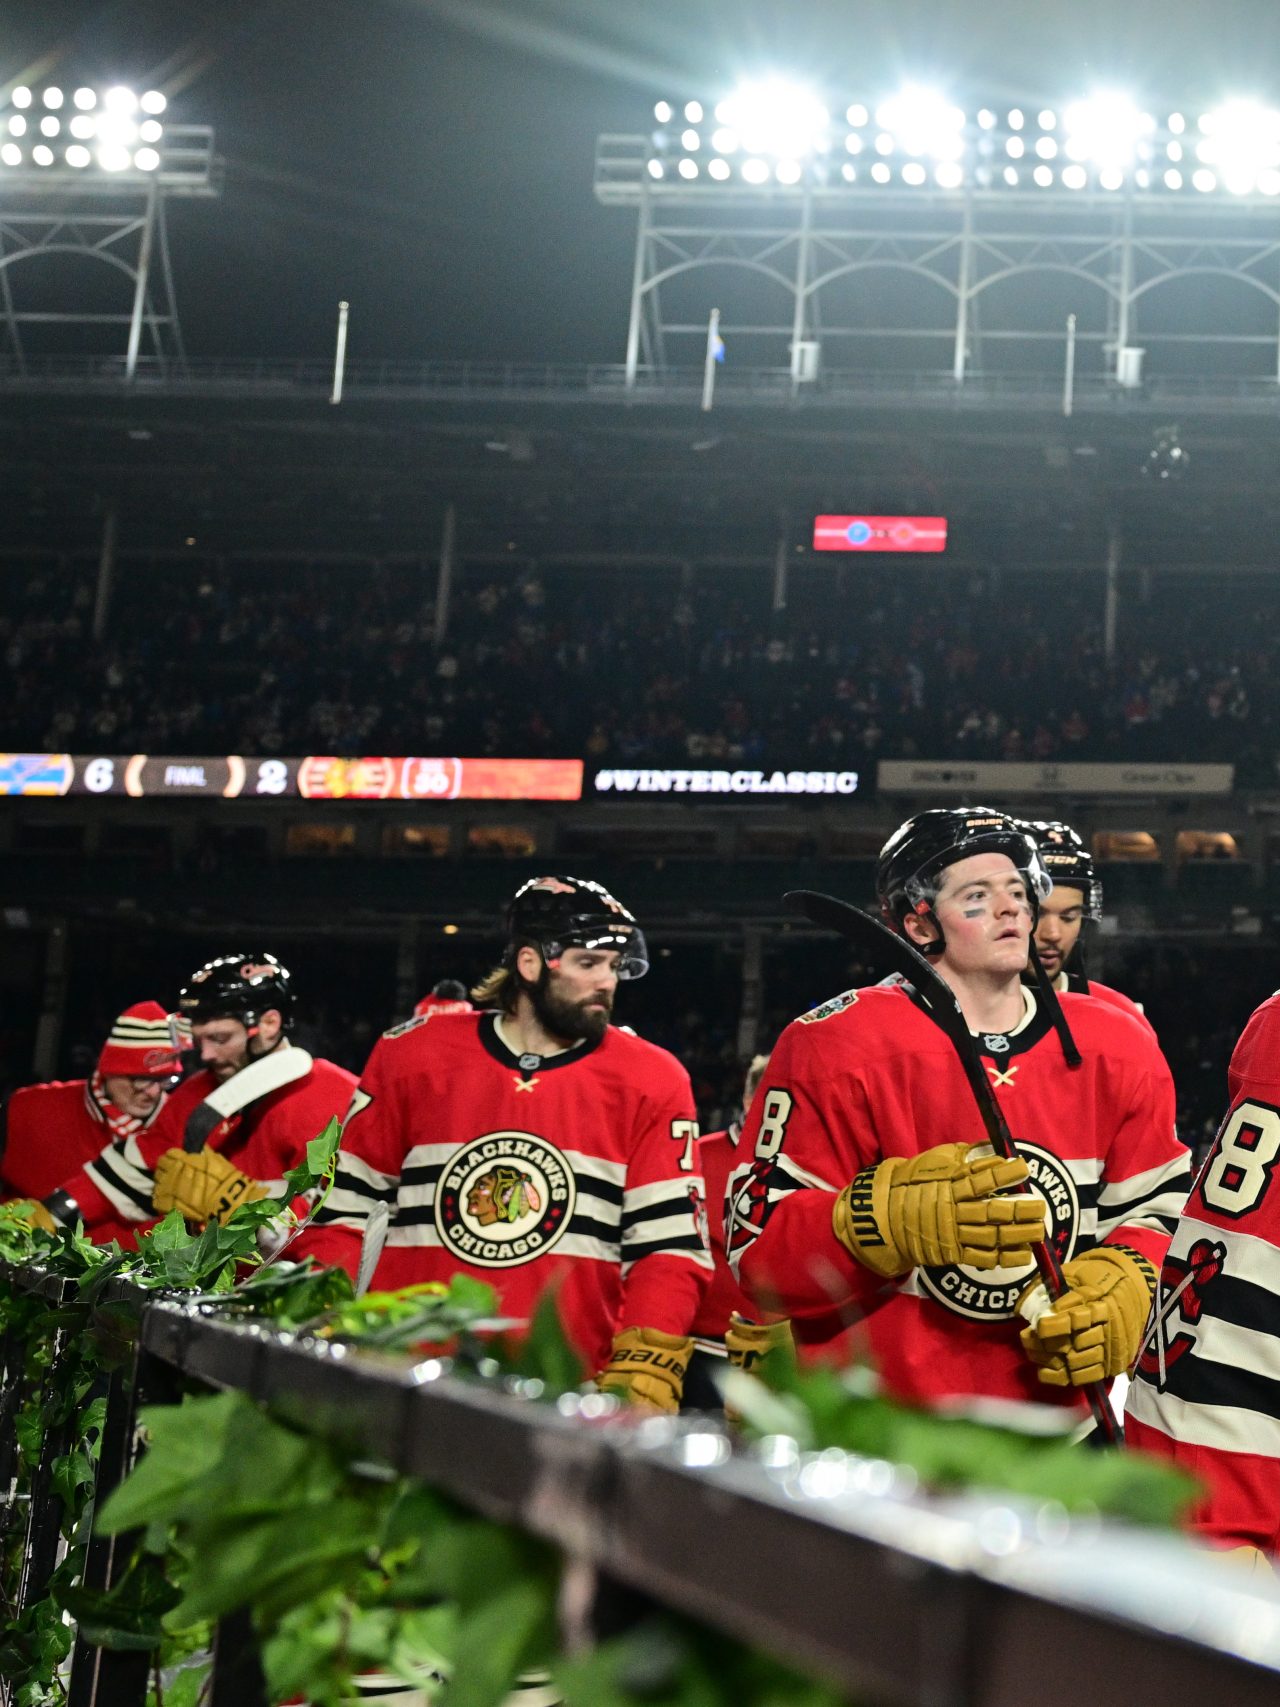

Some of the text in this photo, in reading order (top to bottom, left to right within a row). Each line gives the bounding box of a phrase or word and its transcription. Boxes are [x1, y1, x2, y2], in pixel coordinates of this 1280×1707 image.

[84, 758, 114, 793] 6
[164, 766, 207, 786] FINAL
[256, 760, 288, 794] 2
[595, 770, 858, 793] #WINTERCLASSIC
[754, 1086, 794, 1160] 8
[446, 1140, 568, 1201] BLACKHAWKS
[449, 1223, 543, 1259] CHICAGO
